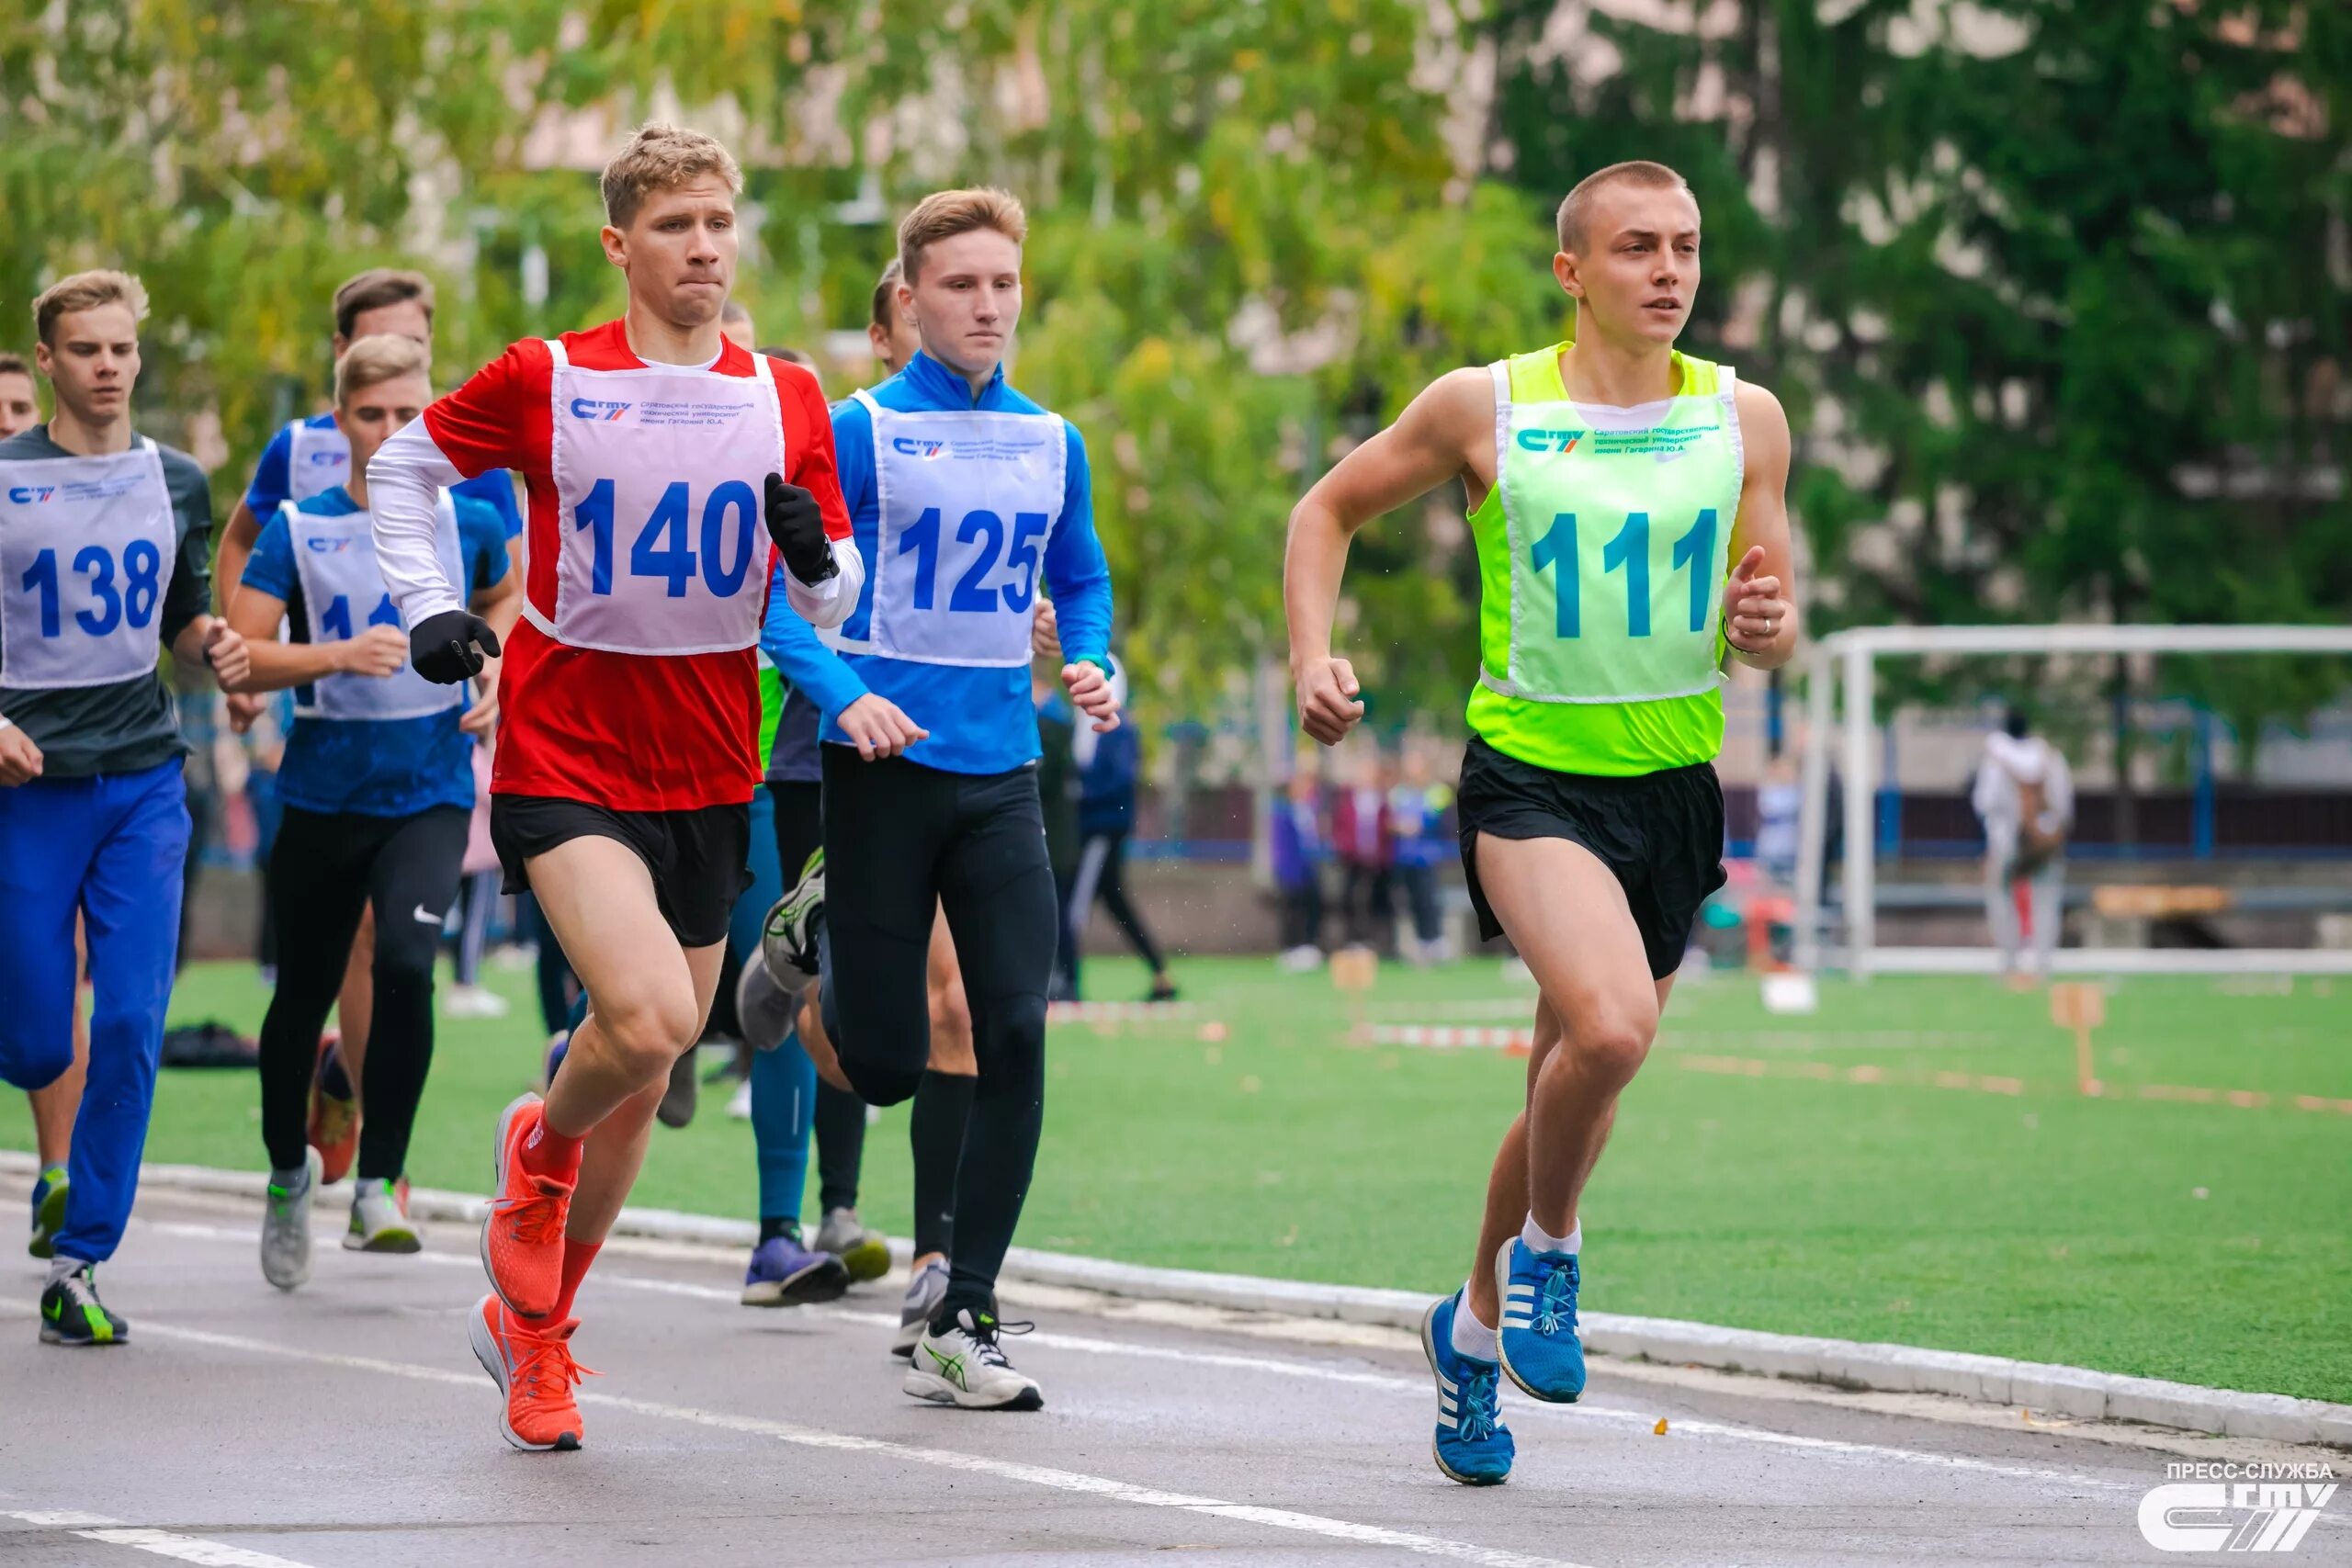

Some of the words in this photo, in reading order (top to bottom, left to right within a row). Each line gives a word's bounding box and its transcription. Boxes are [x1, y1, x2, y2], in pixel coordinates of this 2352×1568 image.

[1594, 428, 1649, 437] Саратовский
[1624, 446, 1665, 454] Гагарина
[1667, 445, 1686, 453] Ю.А.
[1652, 434, 1702, 445] университет
[574, 479, 757, 598] 140
[899, 508, 1048, 614] 125
[1531, 509, 1717, 638] 111
[22, 539, 160, 637] 138
